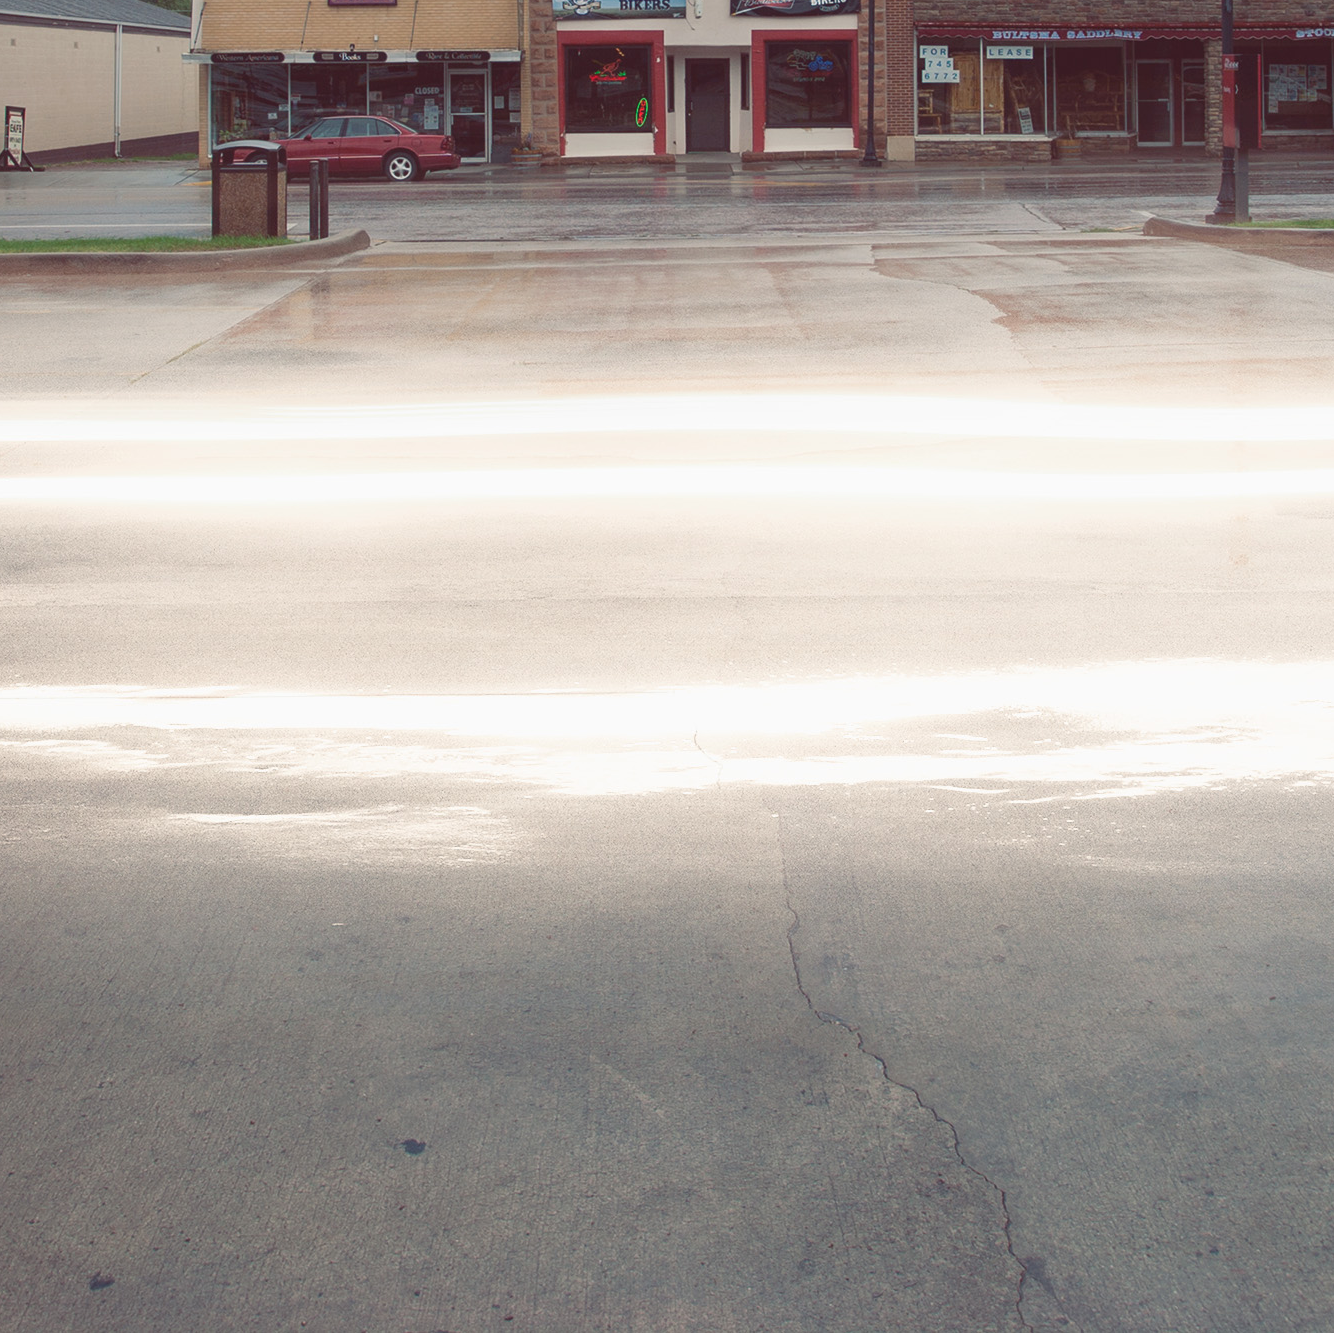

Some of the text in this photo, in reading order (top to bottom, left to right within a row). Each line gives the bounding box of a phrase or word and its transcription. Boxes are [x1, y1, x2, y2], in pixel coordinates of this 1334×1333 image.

[619, 0, 671, 11] BIKERS
[992, 28, 1142, 40] BULTSMA SADDLERY
[338, 52, 361, 61] Books
[922, 48, 1032, 57] FOR LEASE
[928, 60, 952, 68] 745
[924, 72, 958, 80] 6772
[414, 86, 440, 95] CLOSED
